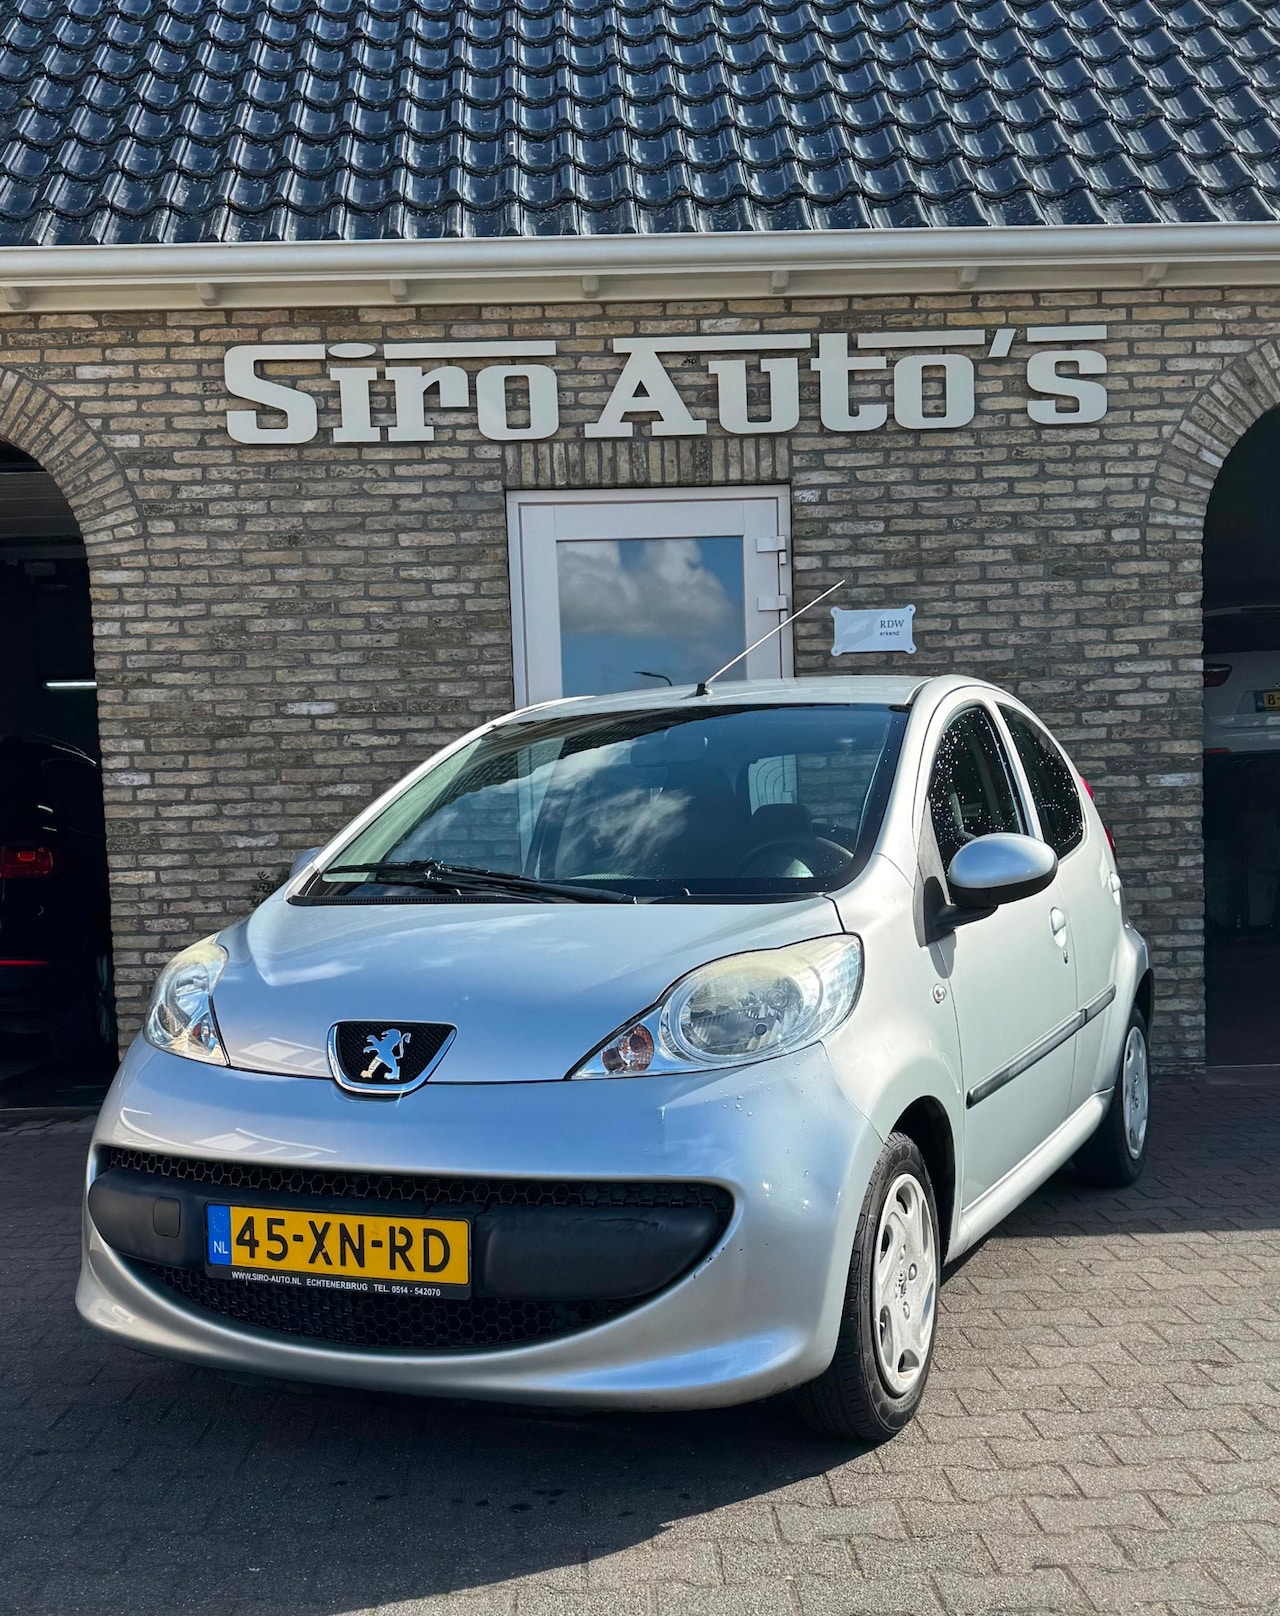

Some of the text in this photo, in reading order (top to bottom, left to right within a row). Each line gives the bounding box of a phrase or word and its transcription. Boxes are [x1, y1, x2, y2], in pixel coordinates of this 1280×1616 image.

[224, 325, 1108, 444] Siro Auto's
[880, 620, 904, 629] RDW
[213, 1215, 451, 1273] NL 45-XN-RD
[231, 1271, 302, 1285] WWW.SIRO-AUTO.NL
[306, 1278, 369, 1291] ECHTENERBRUG
[391, 1285, 408, 1295] 0514
[414, 1287, 441, 1297] 542070
